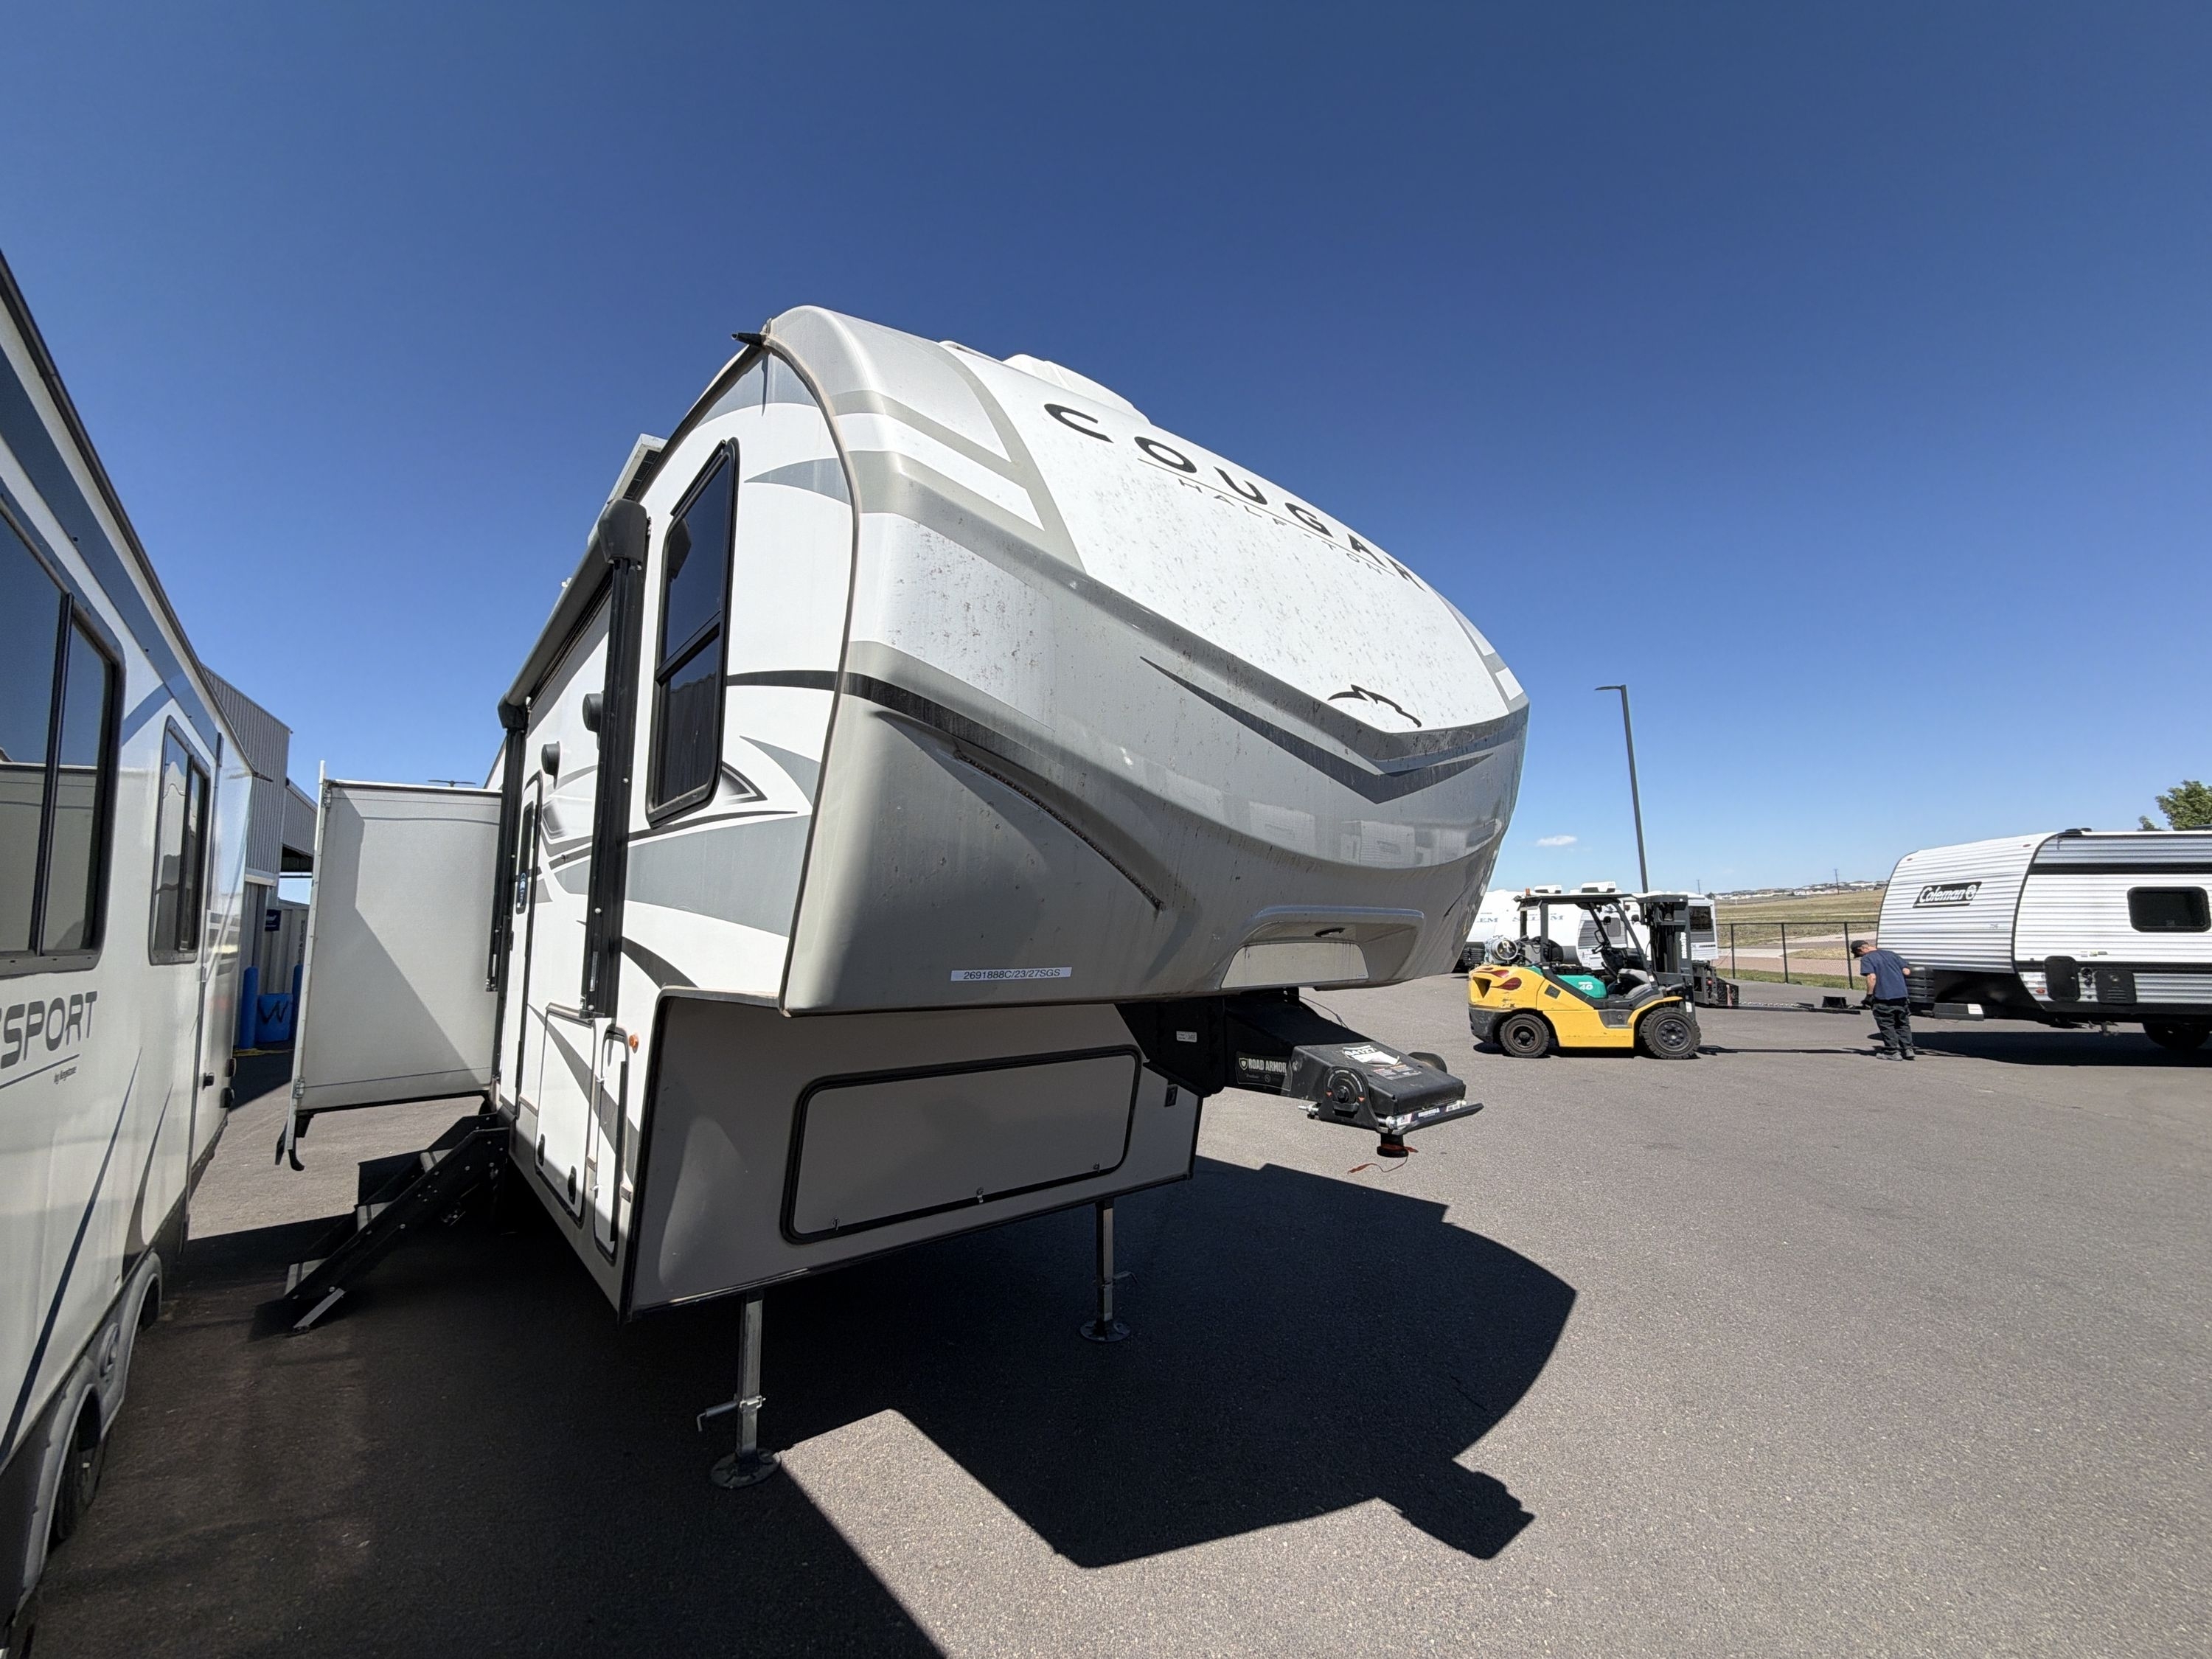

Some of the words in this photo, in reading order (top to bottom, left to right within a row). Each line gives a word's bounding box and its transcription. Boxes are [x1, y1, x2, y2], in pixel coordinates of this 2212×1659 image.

[1044, 403, 1427, 593] COUGAR
[1919, 886, 1966, 903] Coleman
[963, 969, 1061, 980] 2691888C/23/27SGS
[0, 991, 97, 1069] SPORT
[1248, 1058, 1265, 1071] ROAD
[1265, 1060, 1287, 1076] ARMOR
